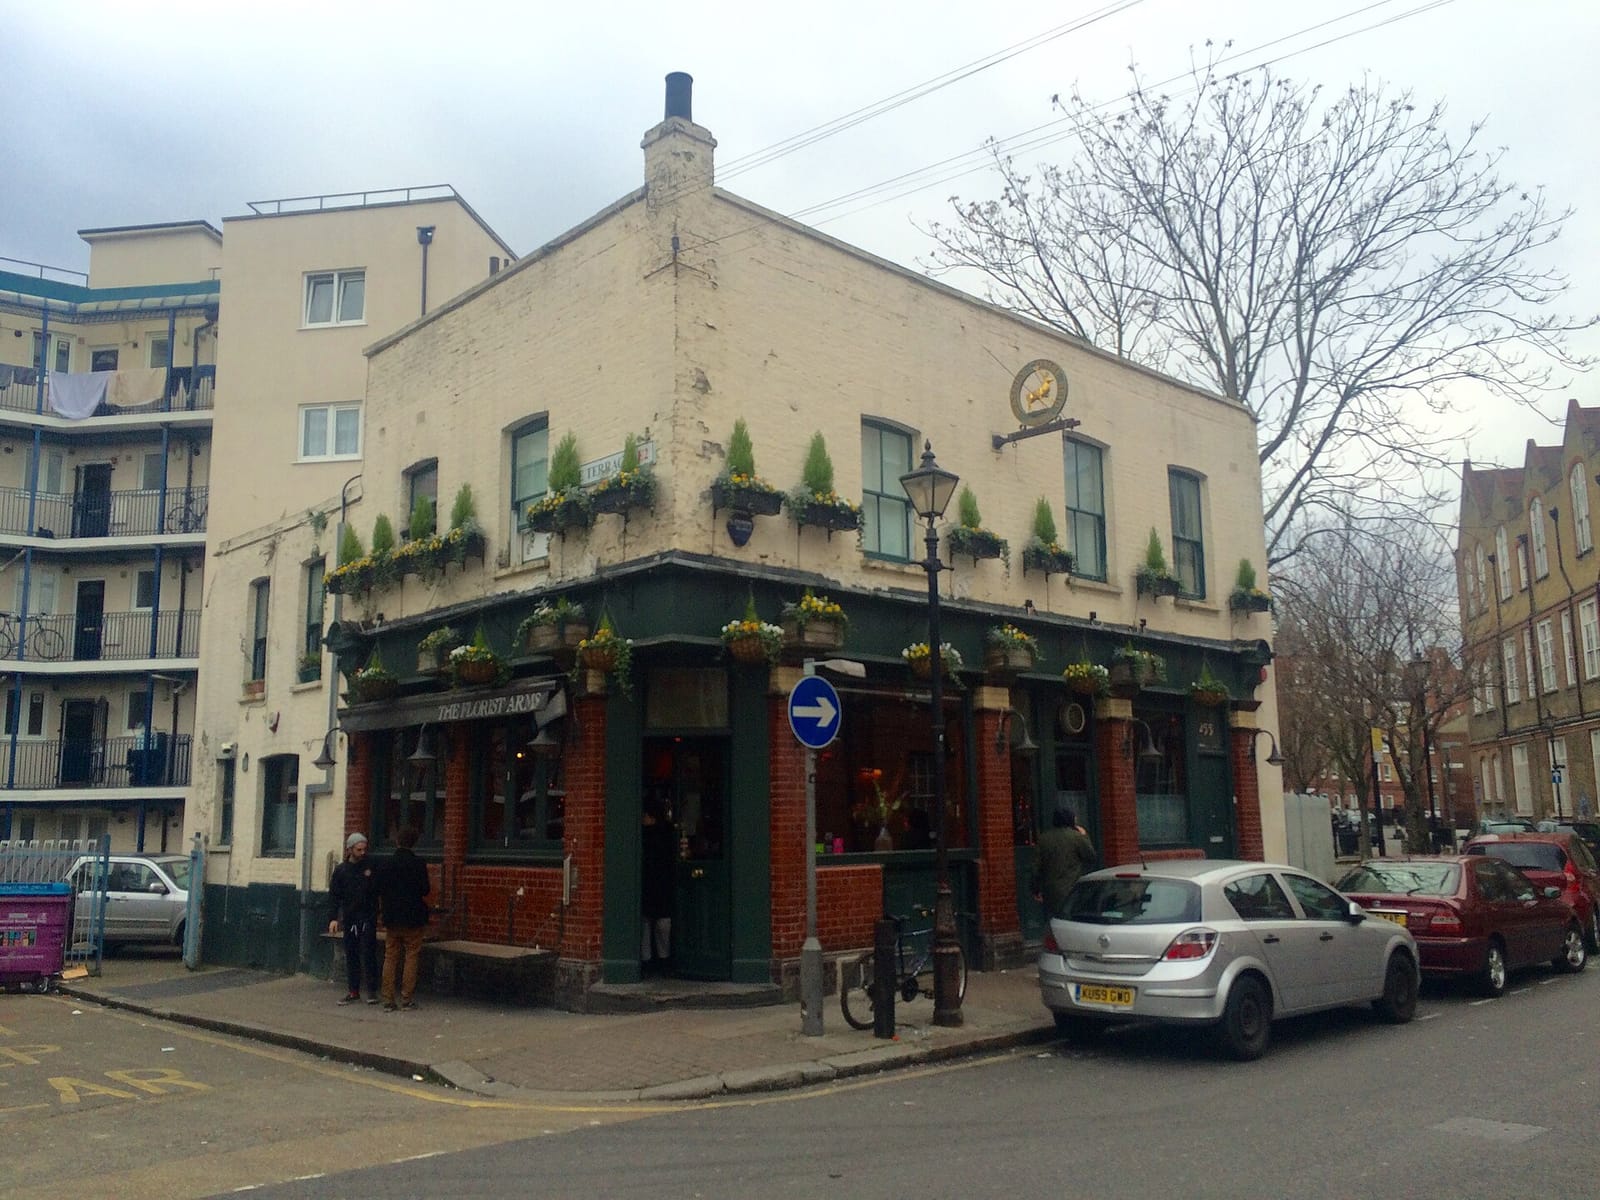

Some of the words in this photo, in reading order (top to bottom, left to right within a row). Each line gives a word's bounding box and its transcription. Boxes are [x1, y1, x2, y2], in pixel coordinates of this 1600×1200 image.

[439, 703, 459, 720] THE
[460, 696, 506, 718] FLORIST
[506, 692, 542, 713] ARMS
